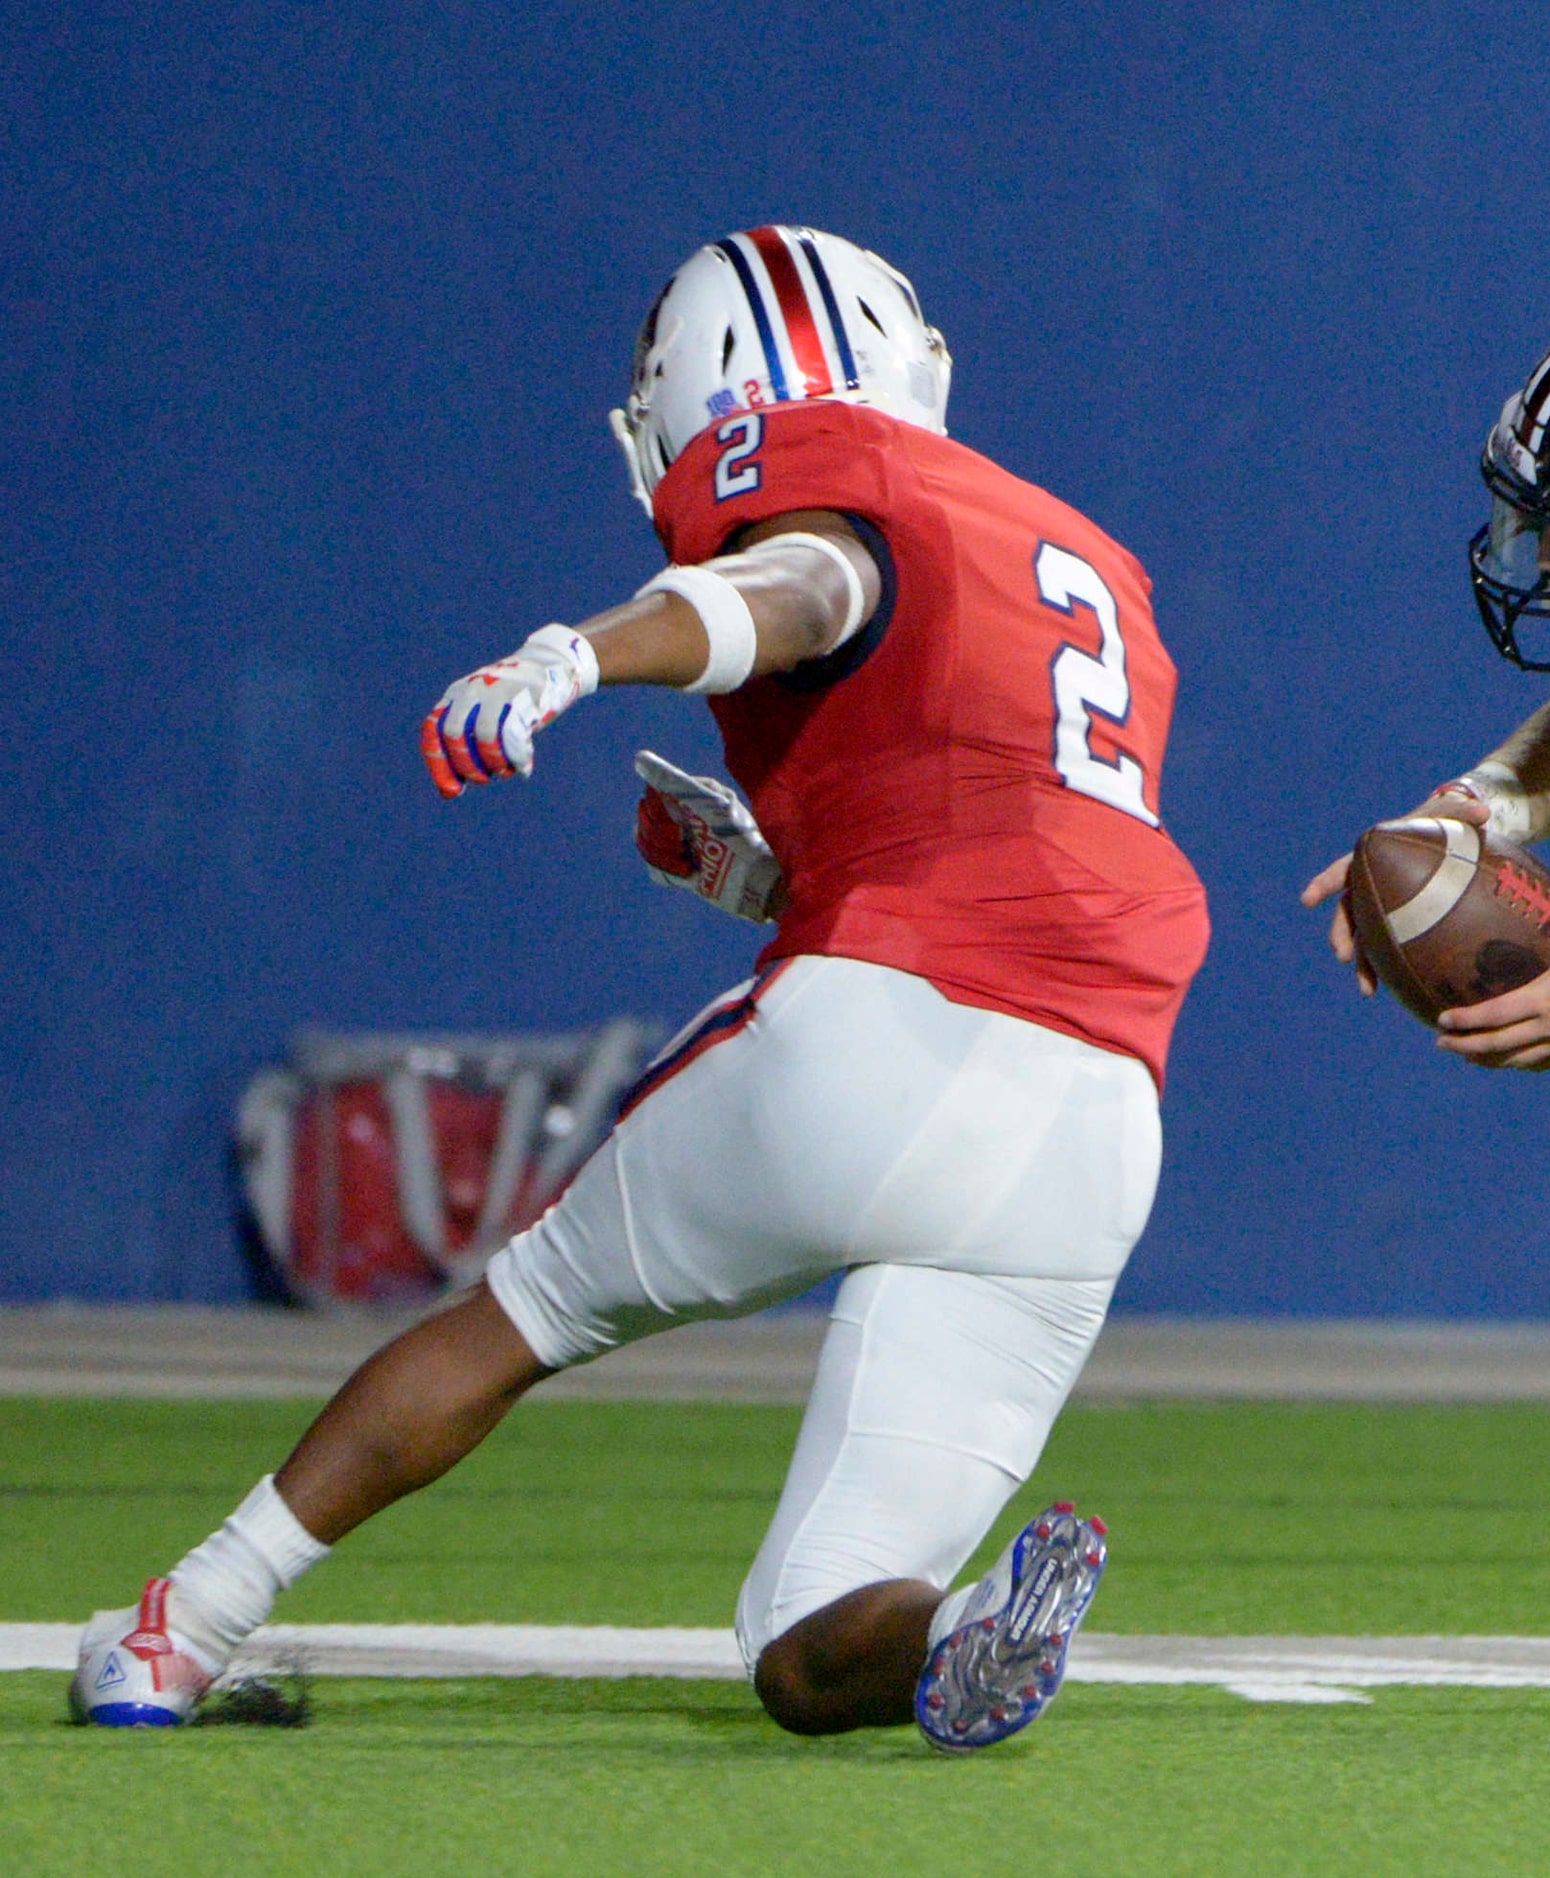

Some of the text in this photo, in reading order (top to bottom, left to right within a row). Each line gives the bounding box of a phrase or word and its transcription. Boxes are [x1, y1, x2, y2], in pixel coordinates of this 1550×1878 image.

[744, 379, 765, 408] 2
[715, 413, 765, 502] 2
[1033, 536, 1161, 830] 2
